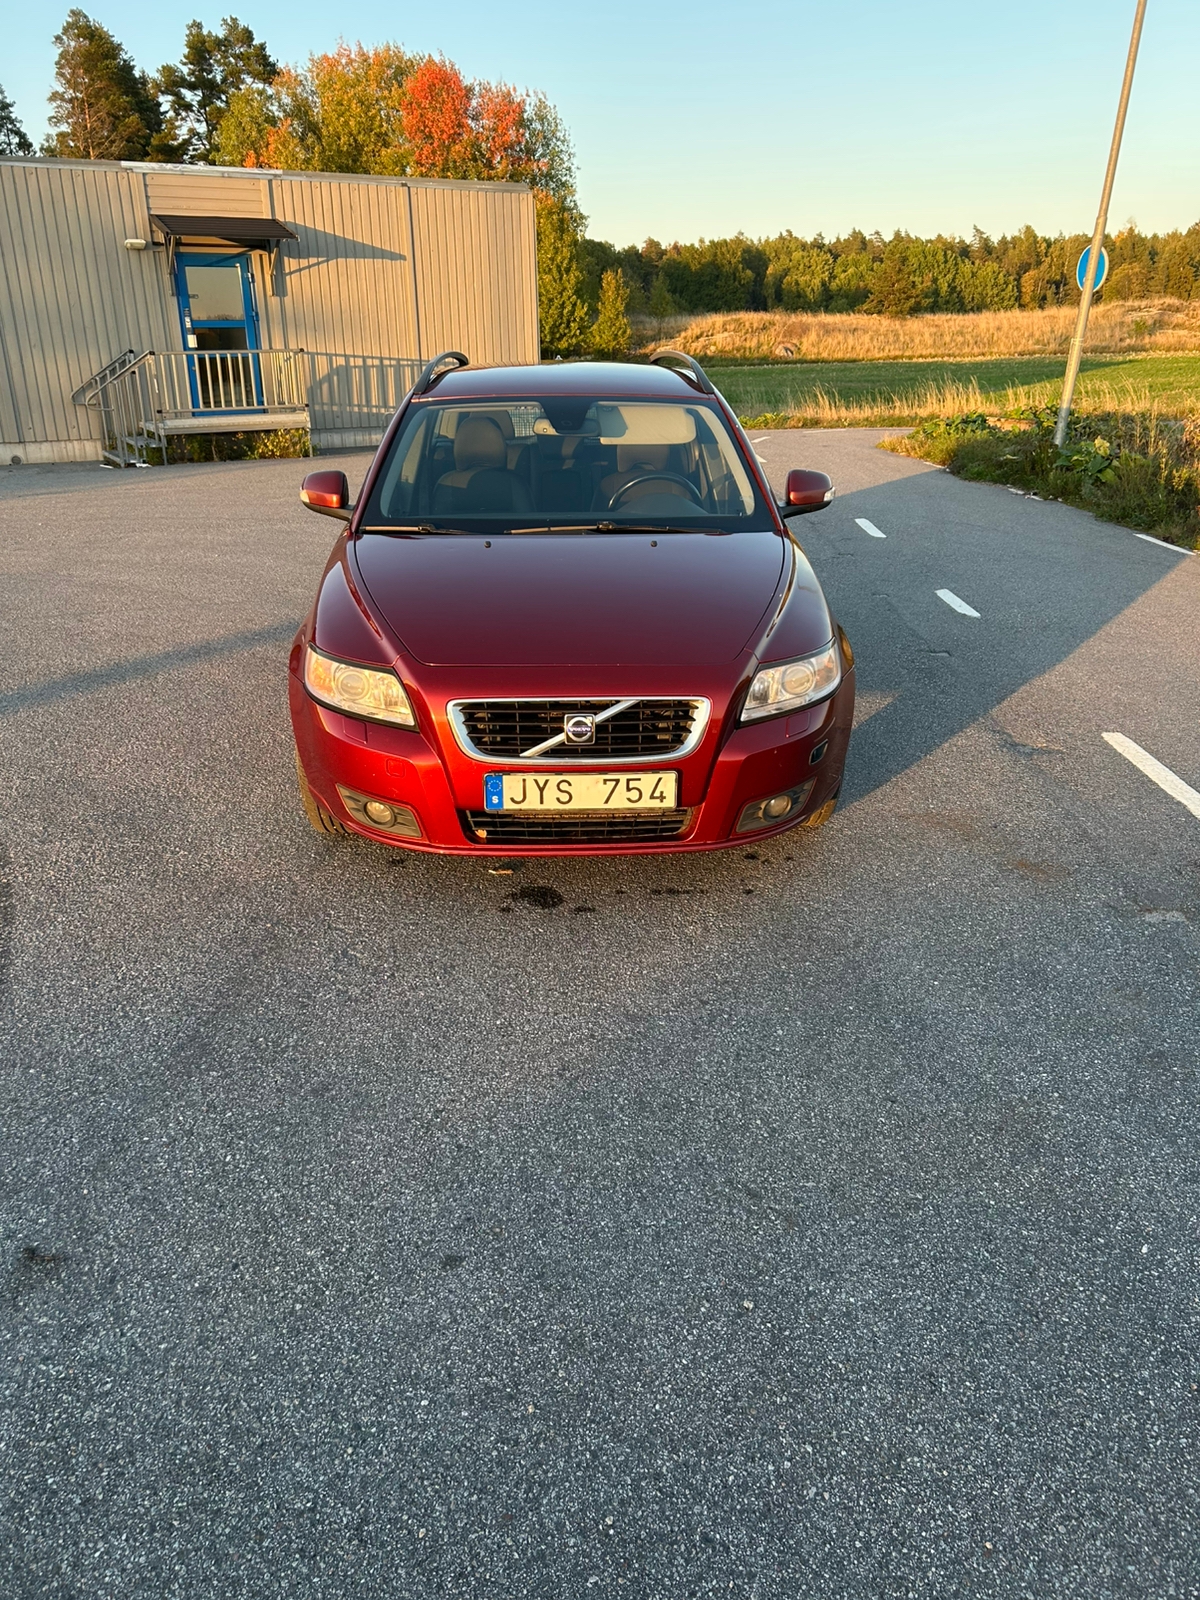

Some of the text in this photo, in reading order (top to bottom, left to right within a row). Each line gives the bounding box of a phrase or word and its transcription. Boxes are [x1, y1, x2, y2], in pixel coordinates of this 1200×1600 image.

[492, 795, 499, 804] S
[509, 777, 666, 804] JYS 754
